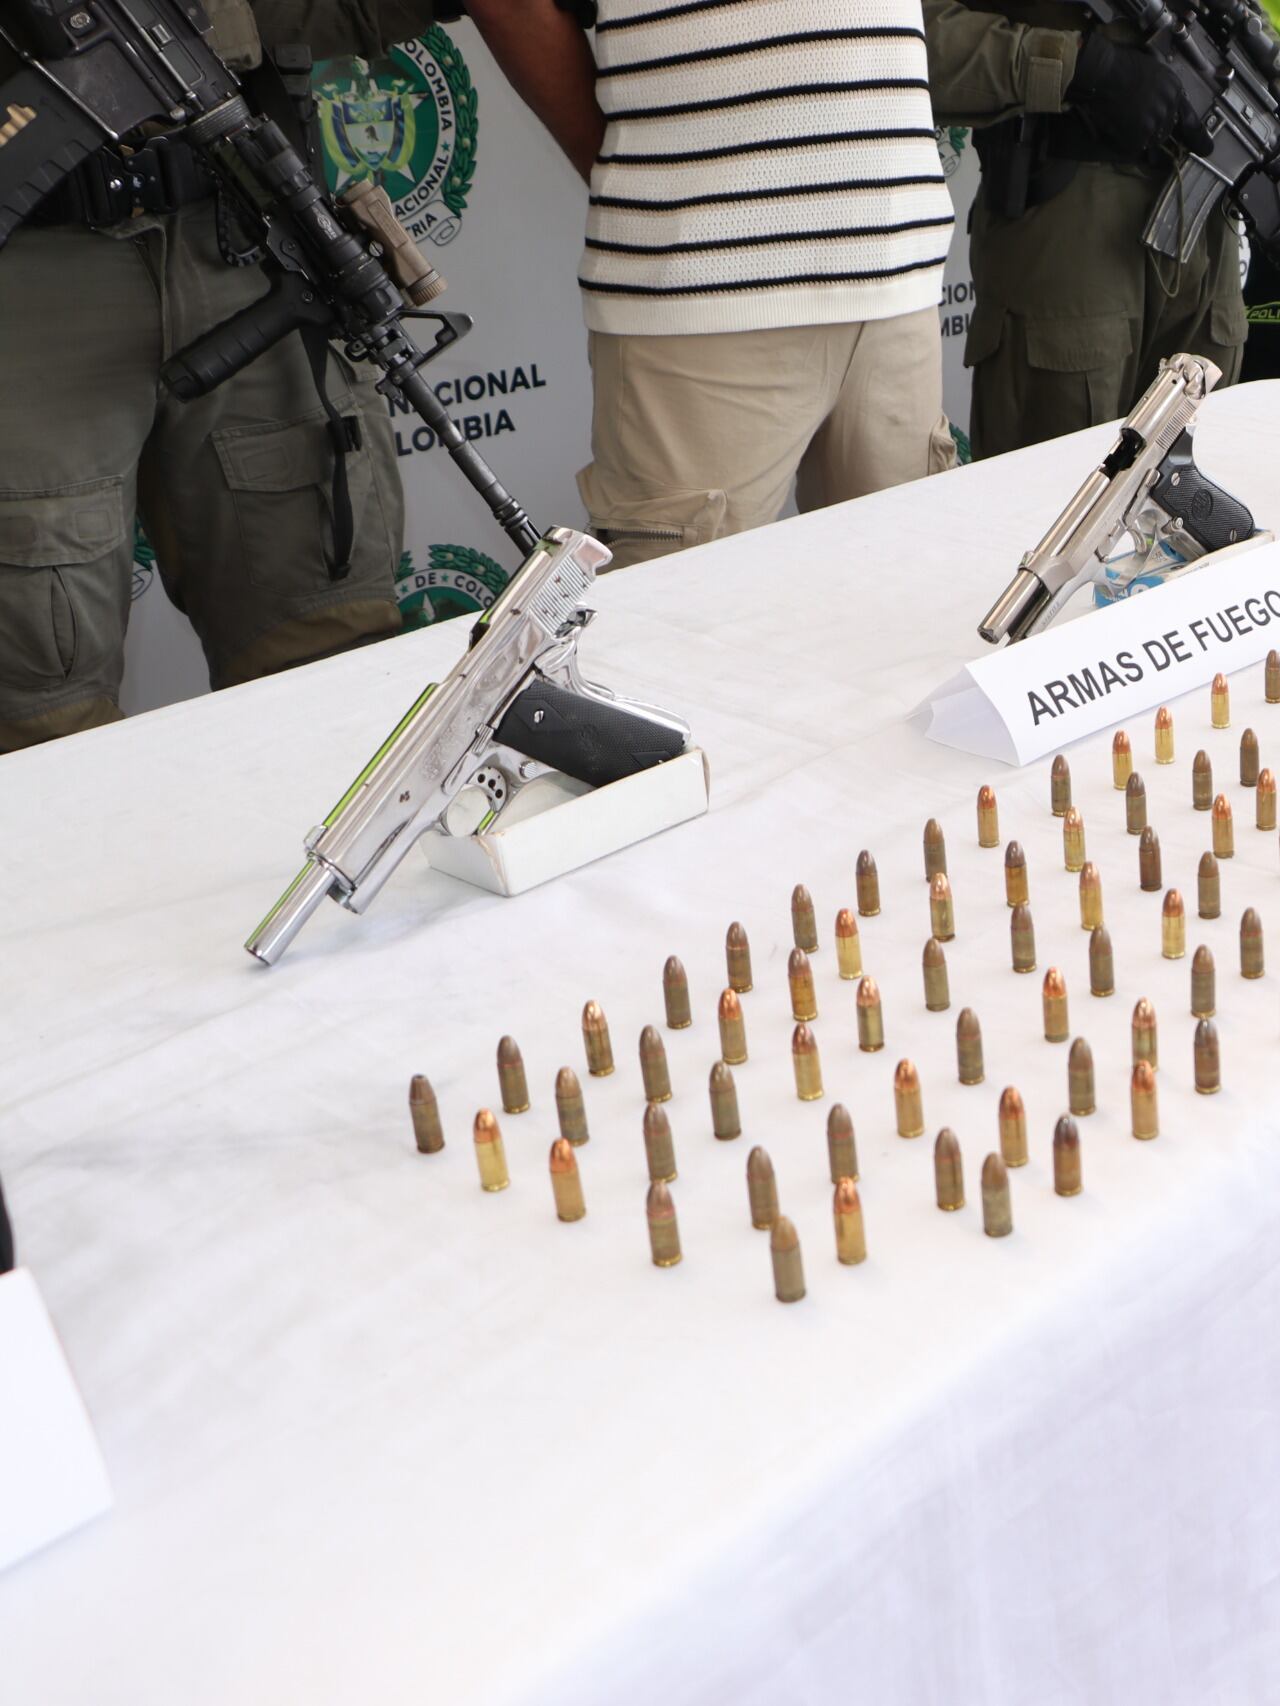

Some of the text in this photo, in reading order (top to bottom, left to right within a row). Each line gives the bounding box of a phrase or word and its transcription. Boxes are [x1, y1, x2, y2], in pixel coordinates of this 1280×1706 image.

[404, 40, 452, 131] OLOMBIA
[394, 154, 449, 218] ACIONAL
[405, 213, 438, 238] RIA
[387, 364, 546, 417] NCIONAL
[394, 409, 516, 457] LOBIA
[415, 572, 495, 608] DE COLO
[1026, 651, 1144, 726] ARMAS
[1142, 630, 1193, 671] DE
